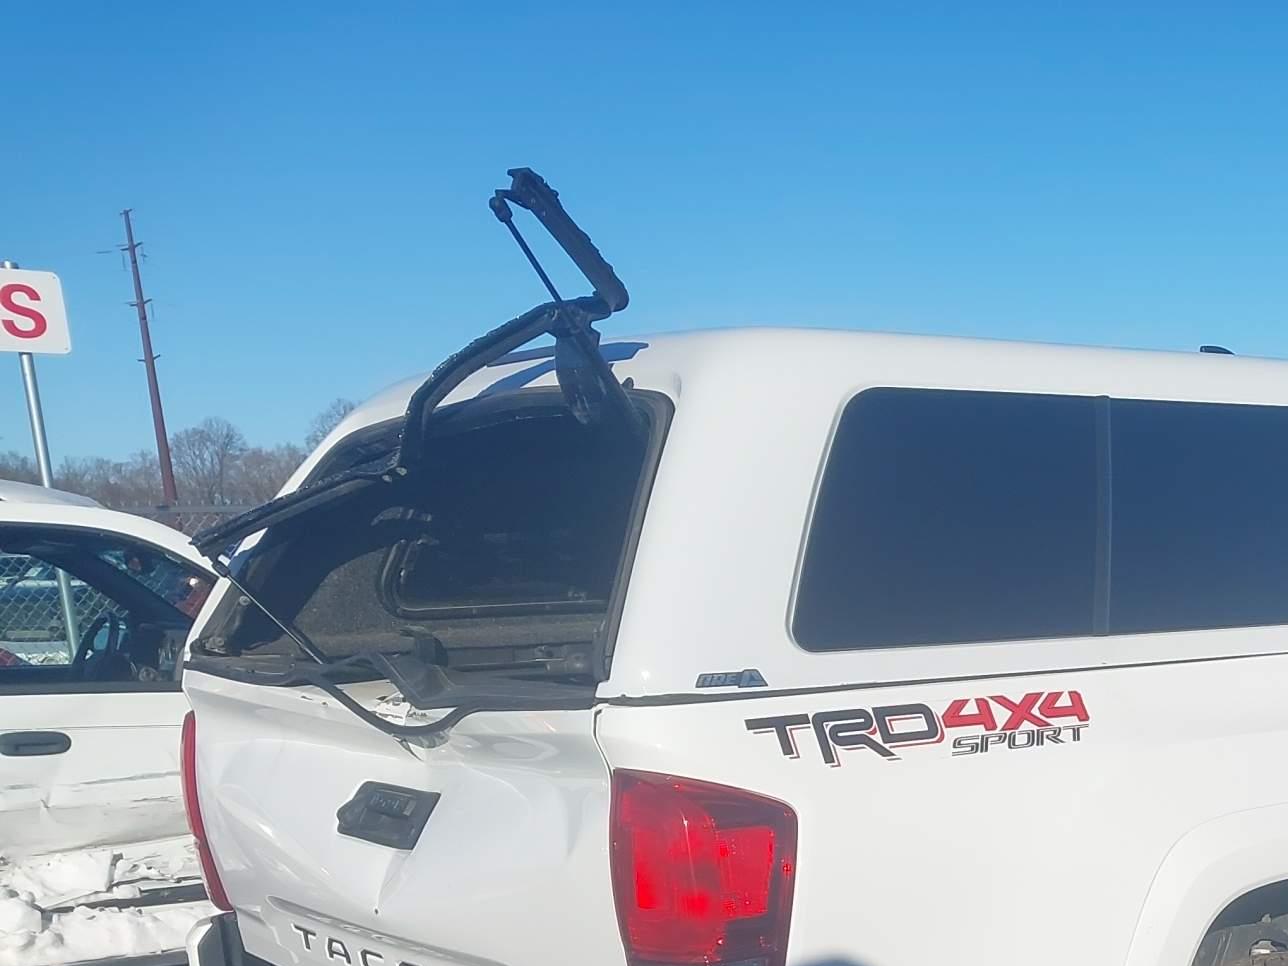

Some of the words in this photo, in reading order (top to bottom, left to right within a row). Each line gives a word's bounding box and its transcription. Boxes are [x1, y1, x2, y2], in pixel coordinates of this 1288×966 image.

[0, 283, 47, 338] S
[744, 702, 945, 768] TRD
[951, 723, 1090, 757] SPORT
